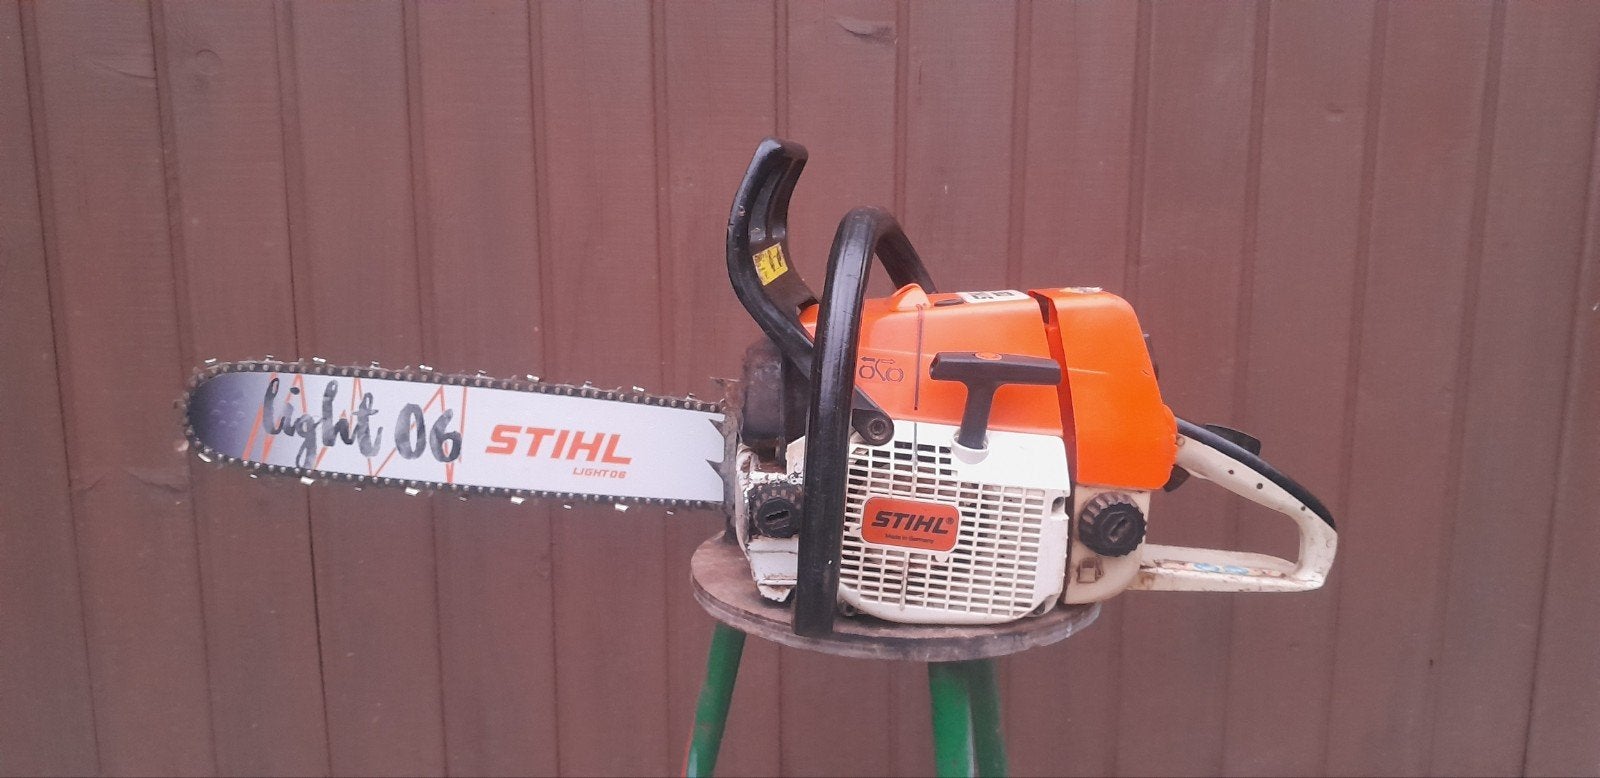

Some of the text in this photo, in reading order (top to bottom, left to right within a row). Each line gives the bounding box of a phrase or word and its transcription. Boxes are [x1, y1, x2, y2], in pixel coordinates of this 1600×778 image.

[263, 378, 463, 469] light 06
[485, 424, 632, 465] STIHL
